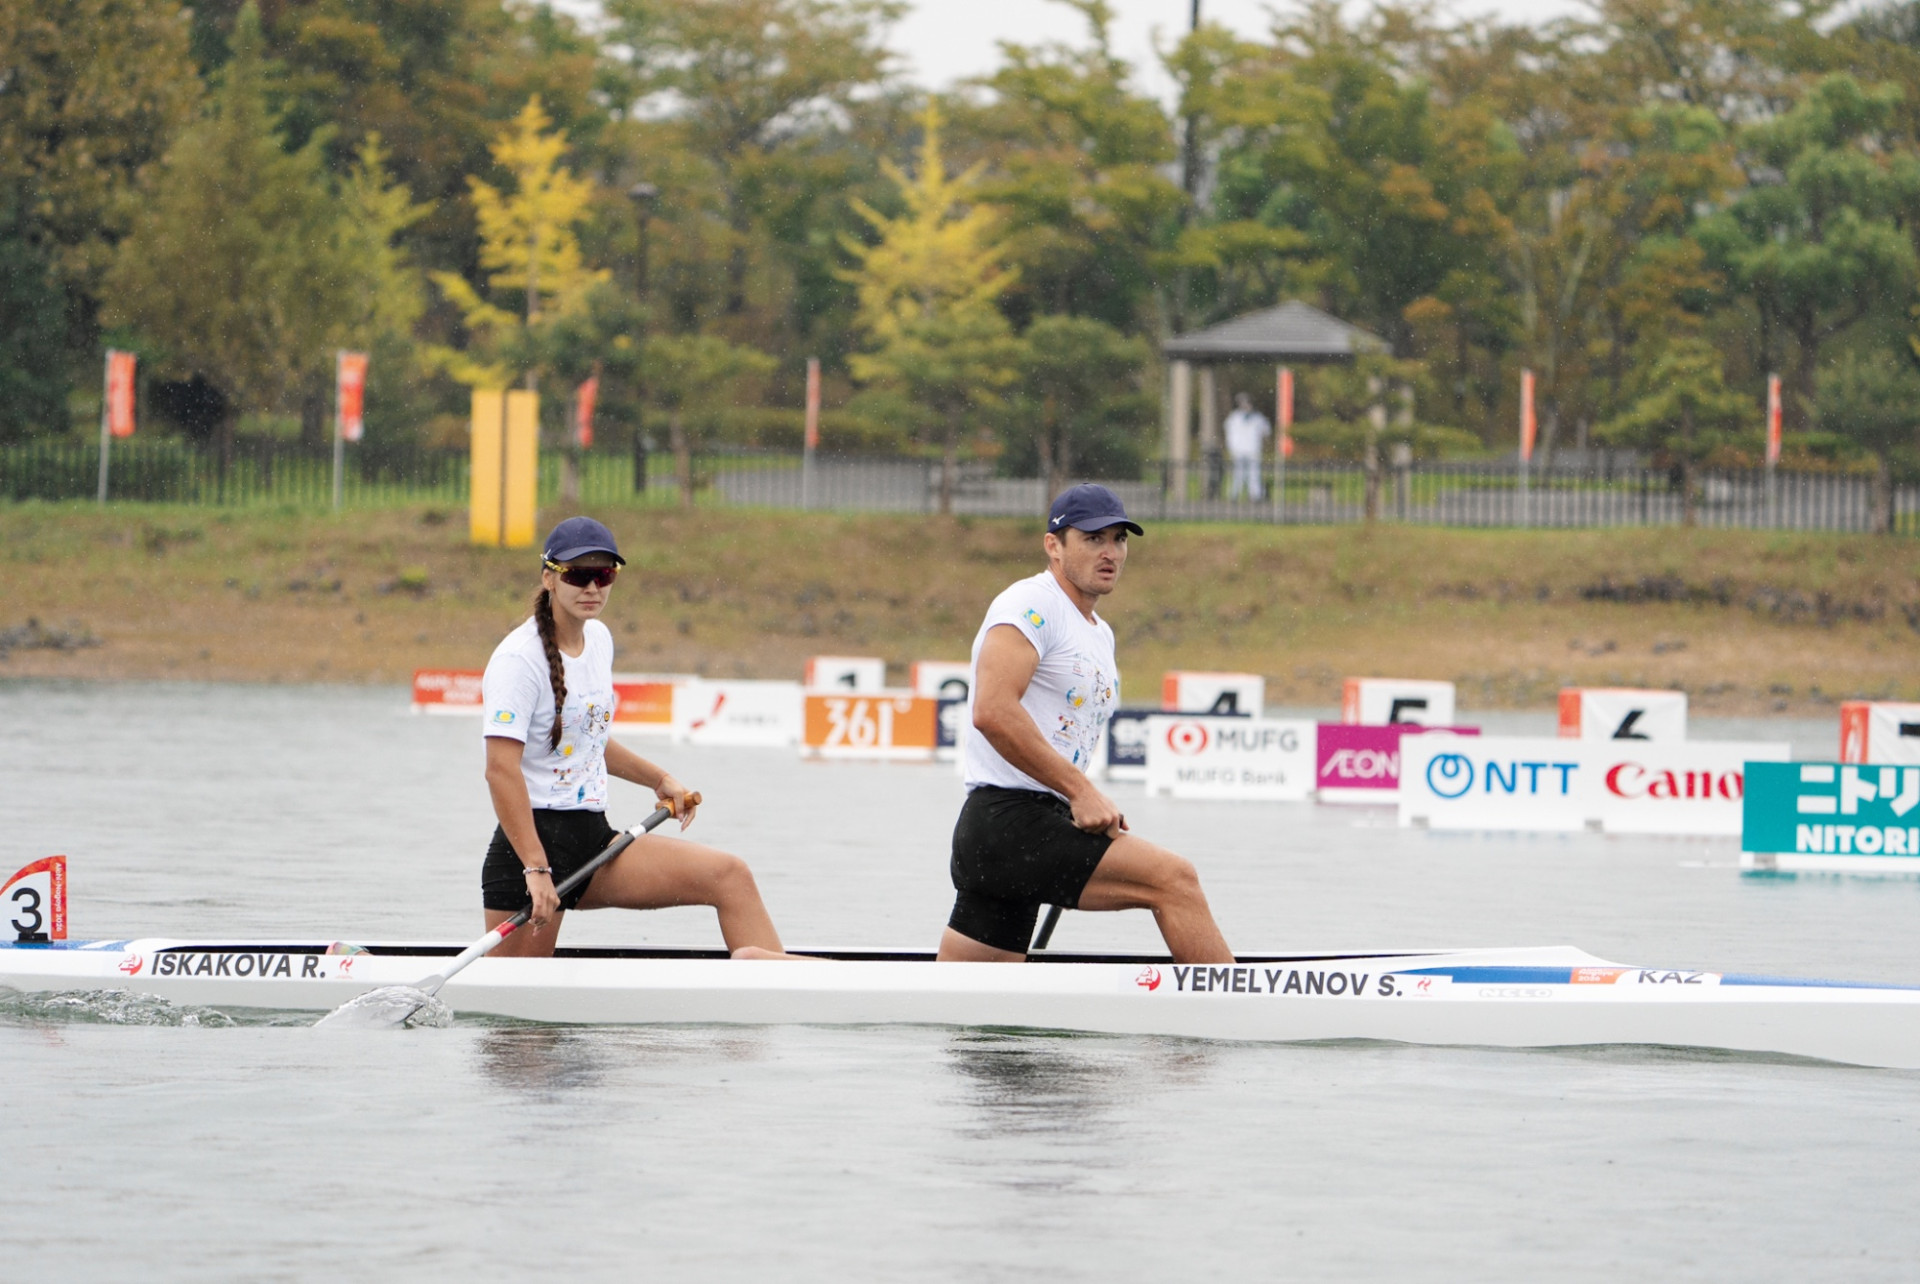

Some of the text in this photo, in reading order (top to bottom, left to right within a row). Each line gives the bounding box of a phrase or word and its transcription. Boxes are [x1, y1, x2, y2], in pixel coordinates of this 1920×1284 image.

[1215, 728, 1300, 752] MUFG
[1177, 767, 1287, 786] MUFG Bank
[1485, 761, 1579, 795] NTT
[1605, 762, 1744, 801] Cano
[1796, 764, 1920, 817] ニトリ
[1796, 823, 1920, 855] NITORI
[10, 886, 43, 933] 3
[151, 952, 327, 979] ISKAKOVA R.
[1172, 965, 1404, 998] YEMELYANOV S.
[1637, 970, 1703, 984] KAZ
